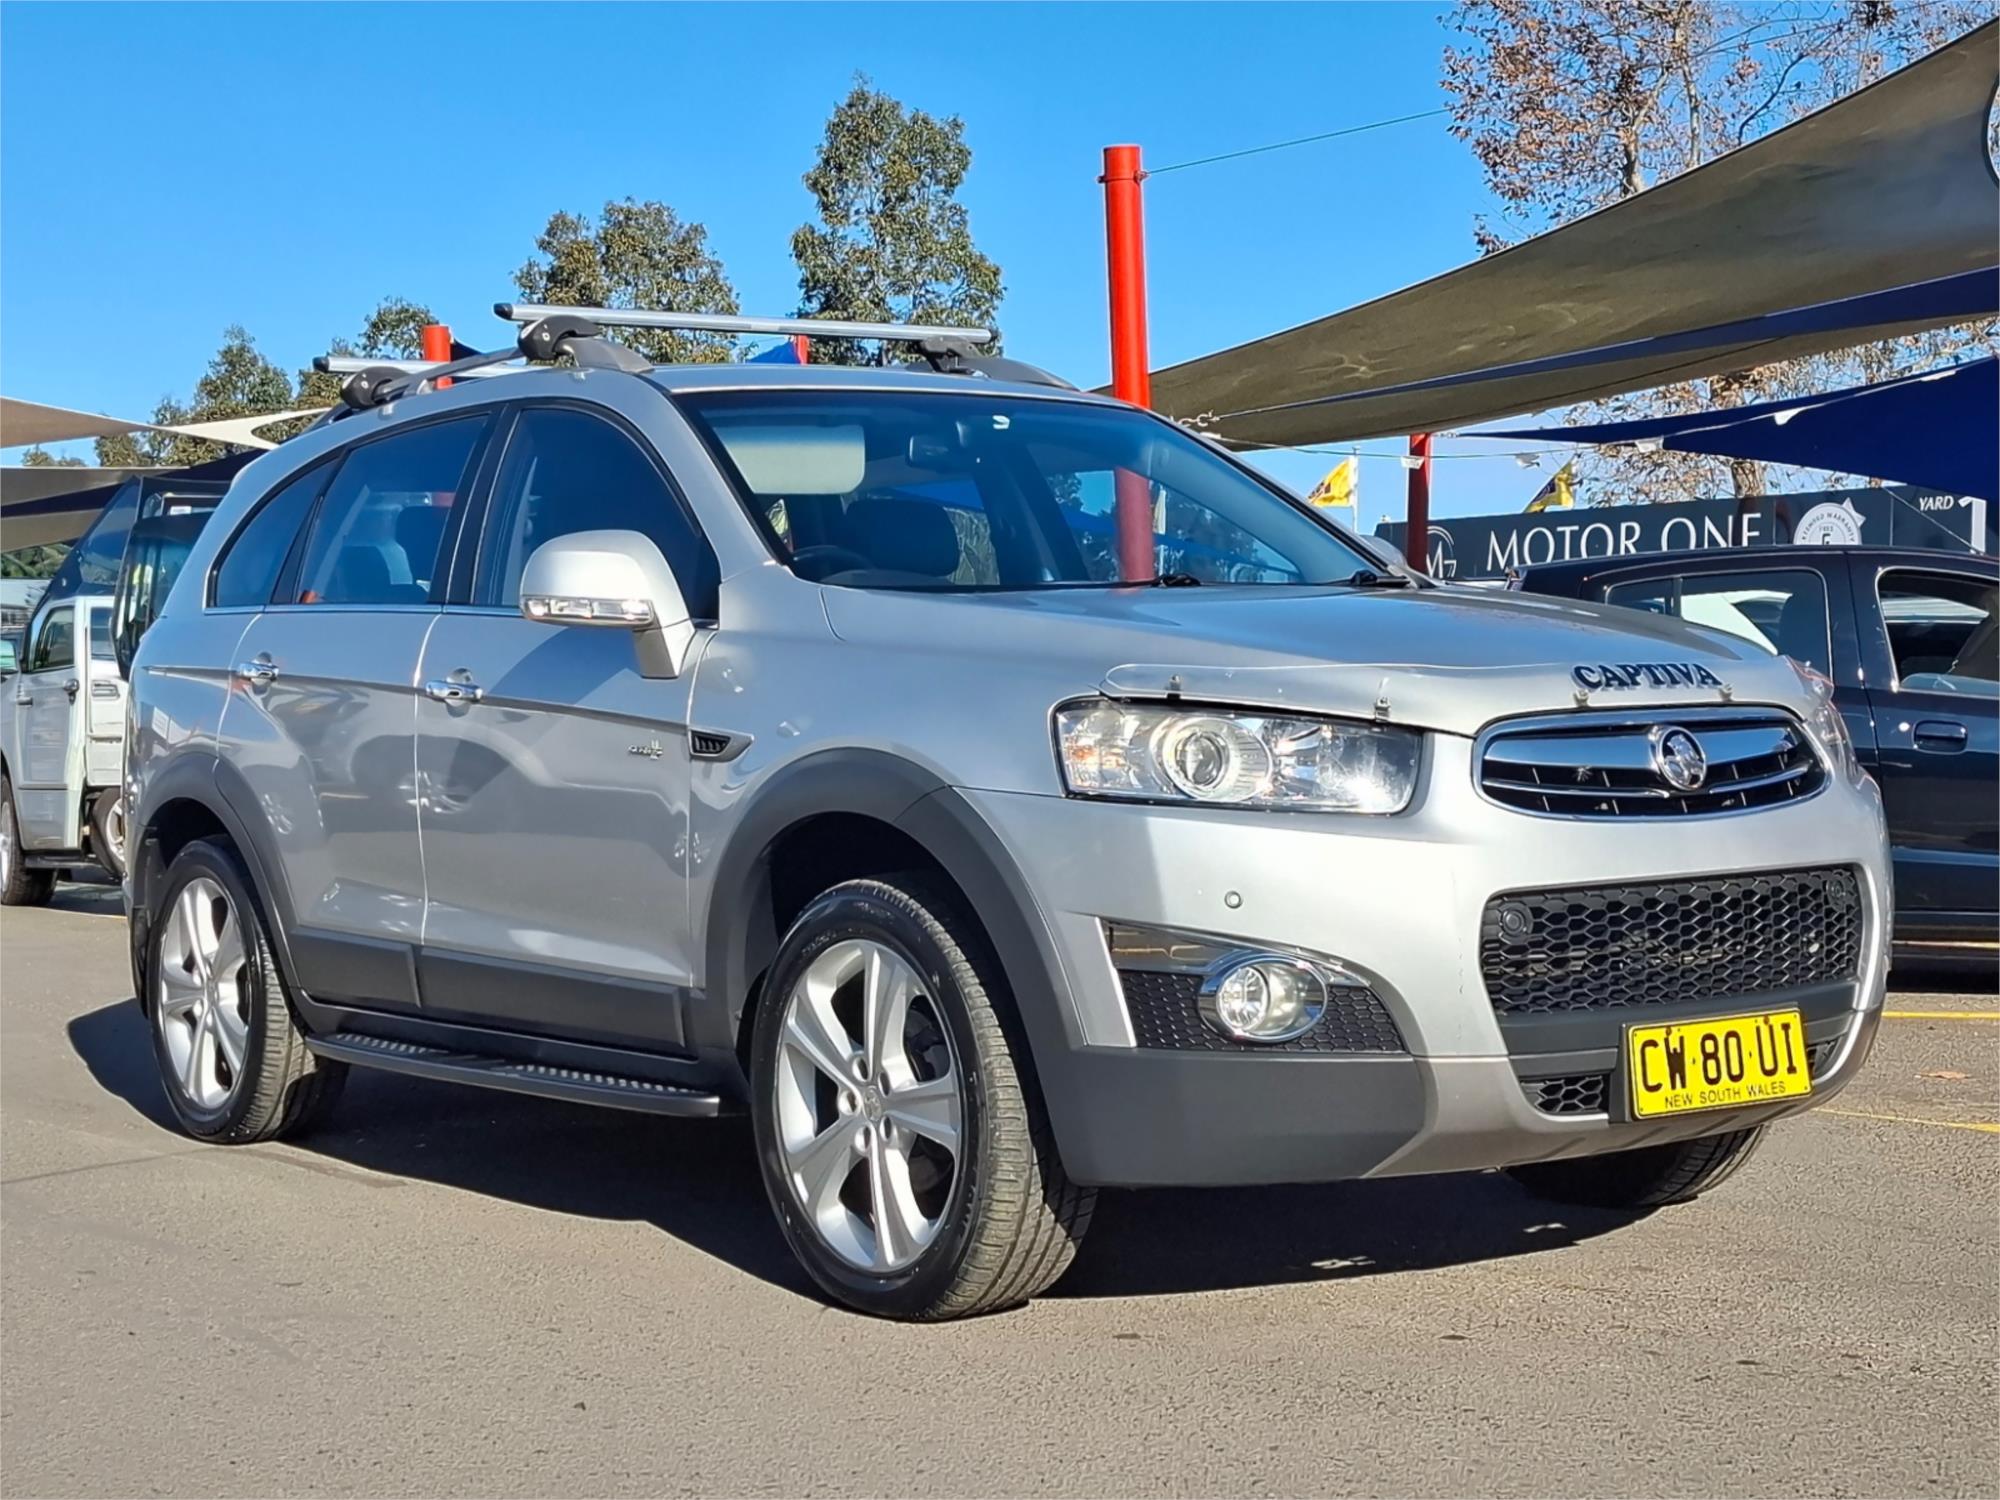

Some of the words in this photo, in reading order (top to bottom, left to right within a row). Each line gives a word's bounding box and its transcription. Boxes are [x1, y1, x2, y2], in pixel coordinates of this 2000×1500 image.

[1919, 495, 1954, 511] YARD
[1486, 521, 1642, 572] MOTOR
[1660, 512, 1762, 551] ONE
[1573, 663, 1723, 690] CAPTIVA
[1664, 1094, 1694, 1109] NEW
[1699, 1088, 1742, 1105] SOUTH
[1745, 1080, 1787, 1097] WALES
